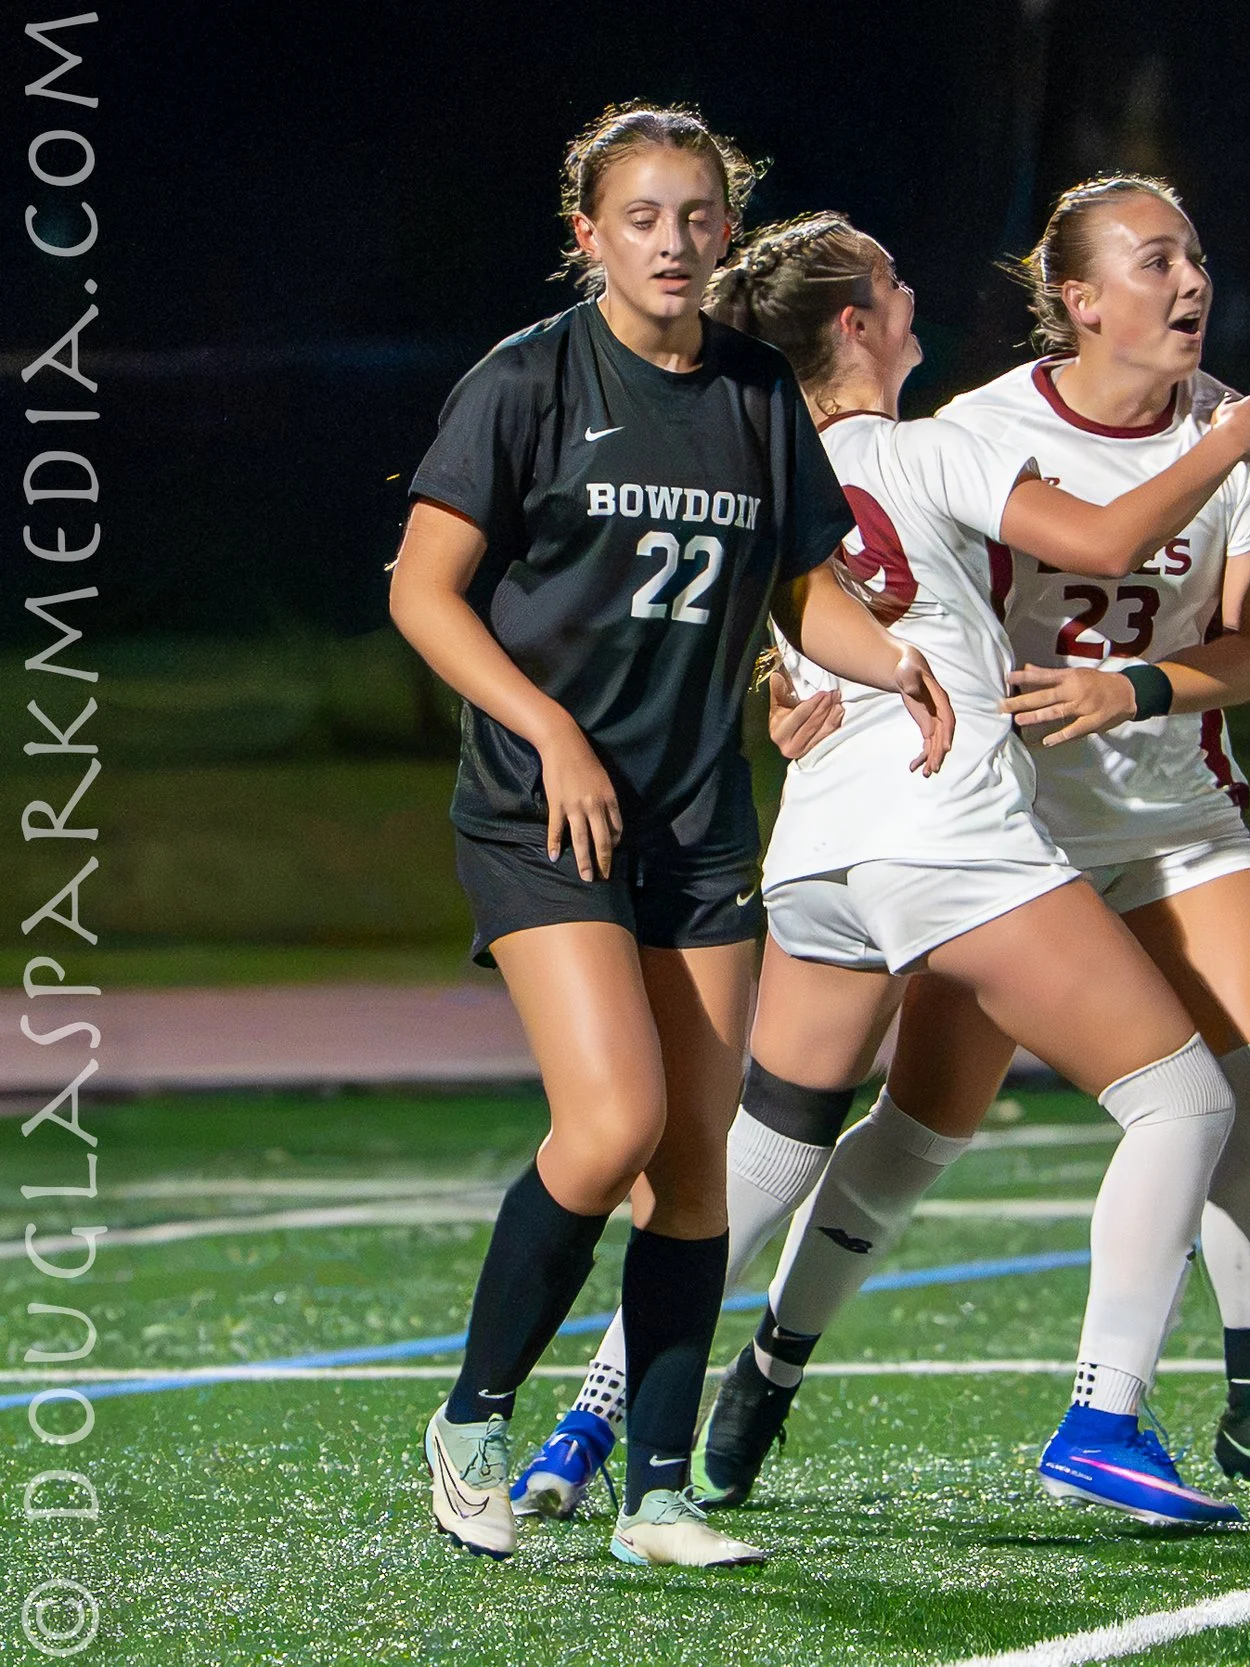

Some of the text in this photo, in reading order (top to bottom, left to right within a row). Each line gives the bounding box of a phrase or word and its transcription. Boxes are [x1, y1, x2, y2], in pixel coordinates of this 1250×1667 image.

[586, 482, 761, 531] BOWDOIN
[631, 531, 723, 625] 22
[1055, 584, 1160, 659] 23
